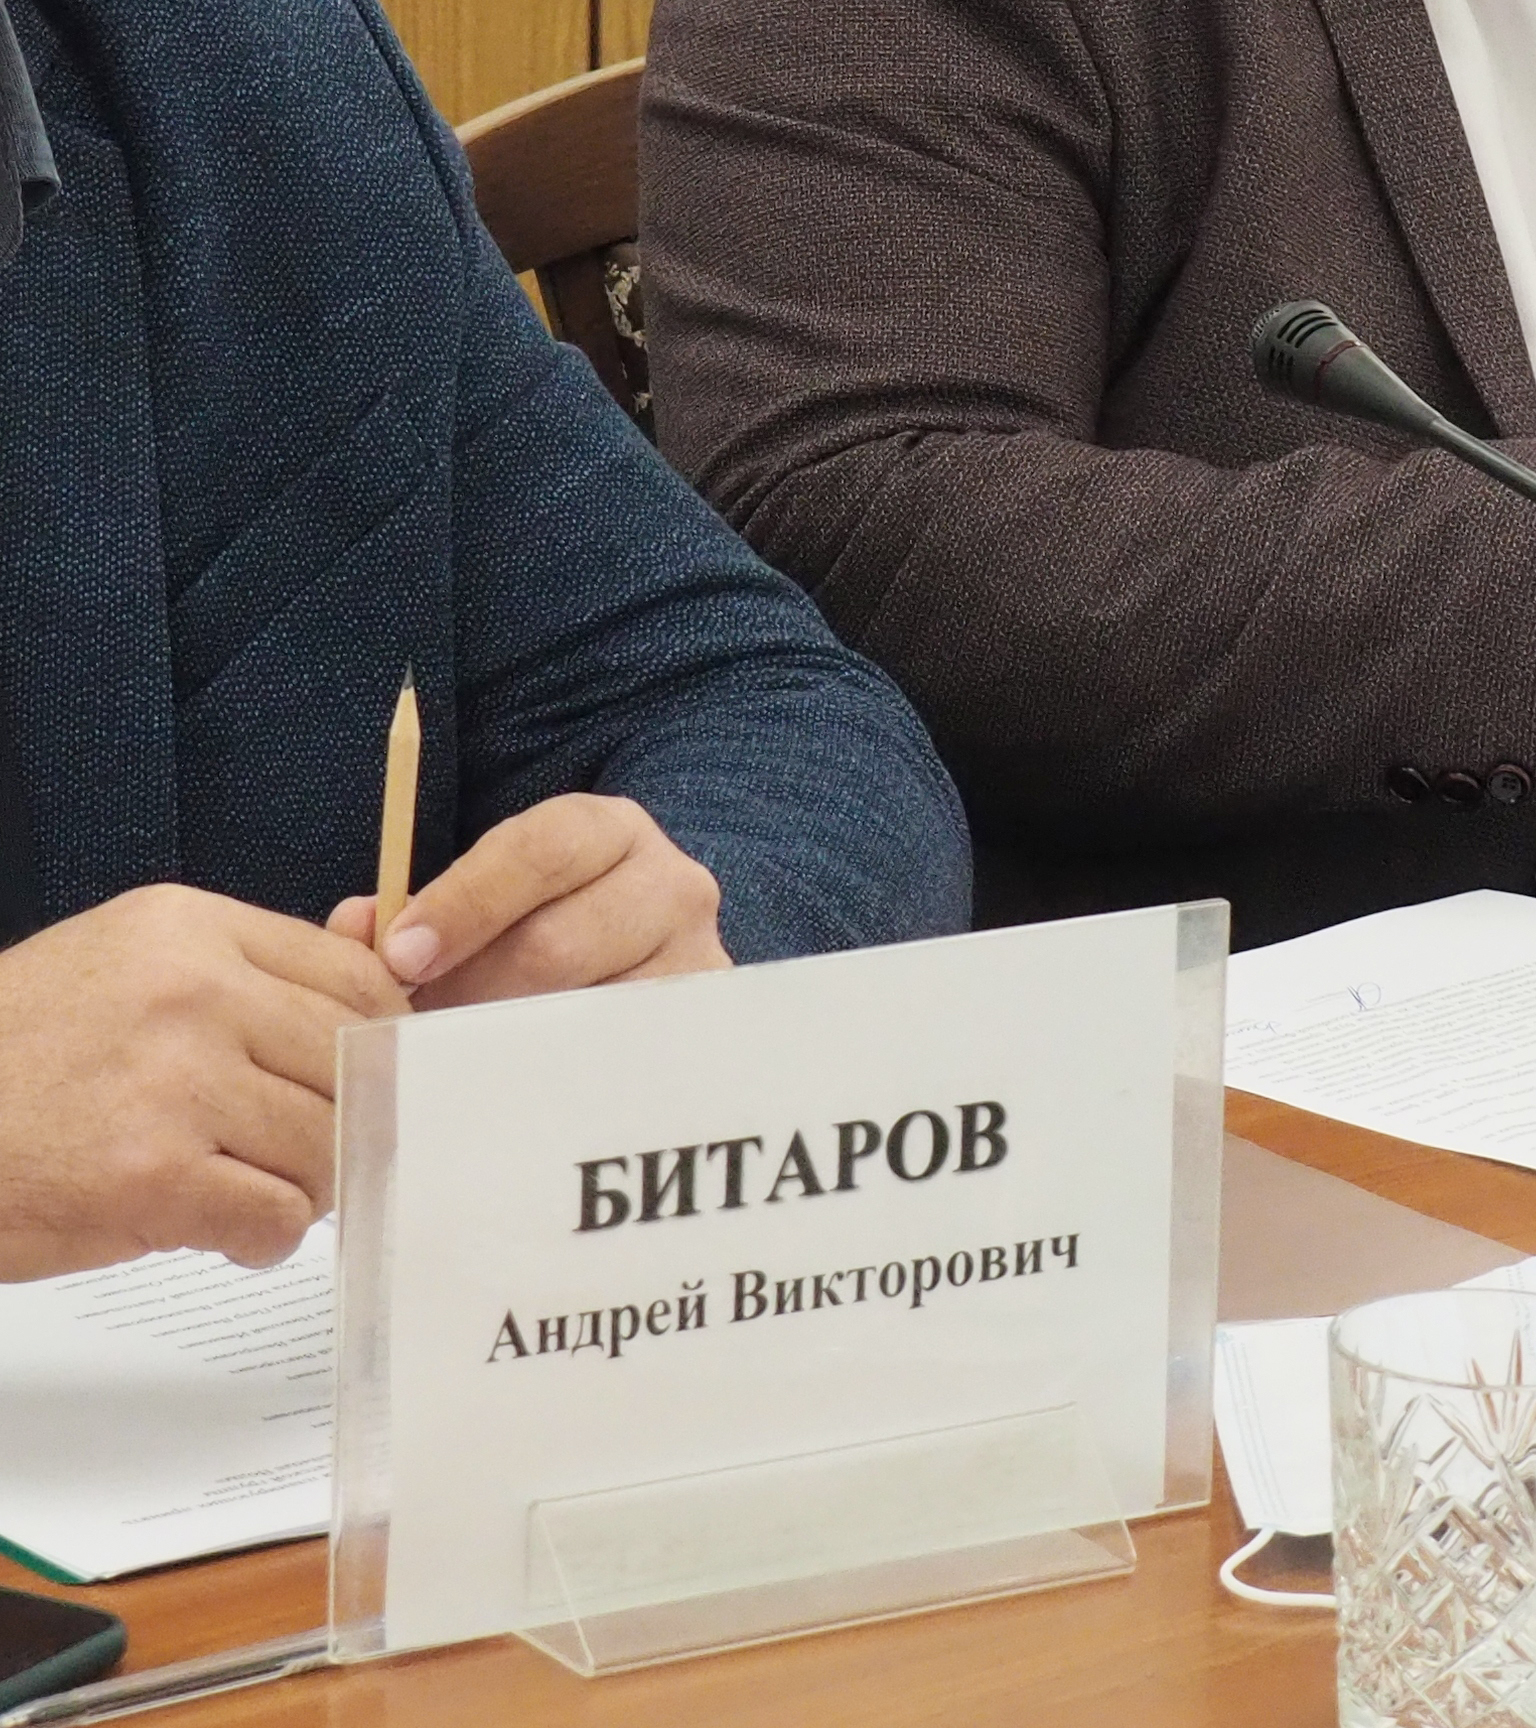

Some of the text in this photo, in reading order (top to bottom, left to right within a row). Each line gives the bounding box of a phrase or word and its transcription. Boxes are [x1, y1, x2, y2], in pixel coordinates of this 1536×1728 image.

[572, 1100, 1010, 1235] БИТАРОВ
[486, 1232, 1082, 1364] Андрей Викторович
